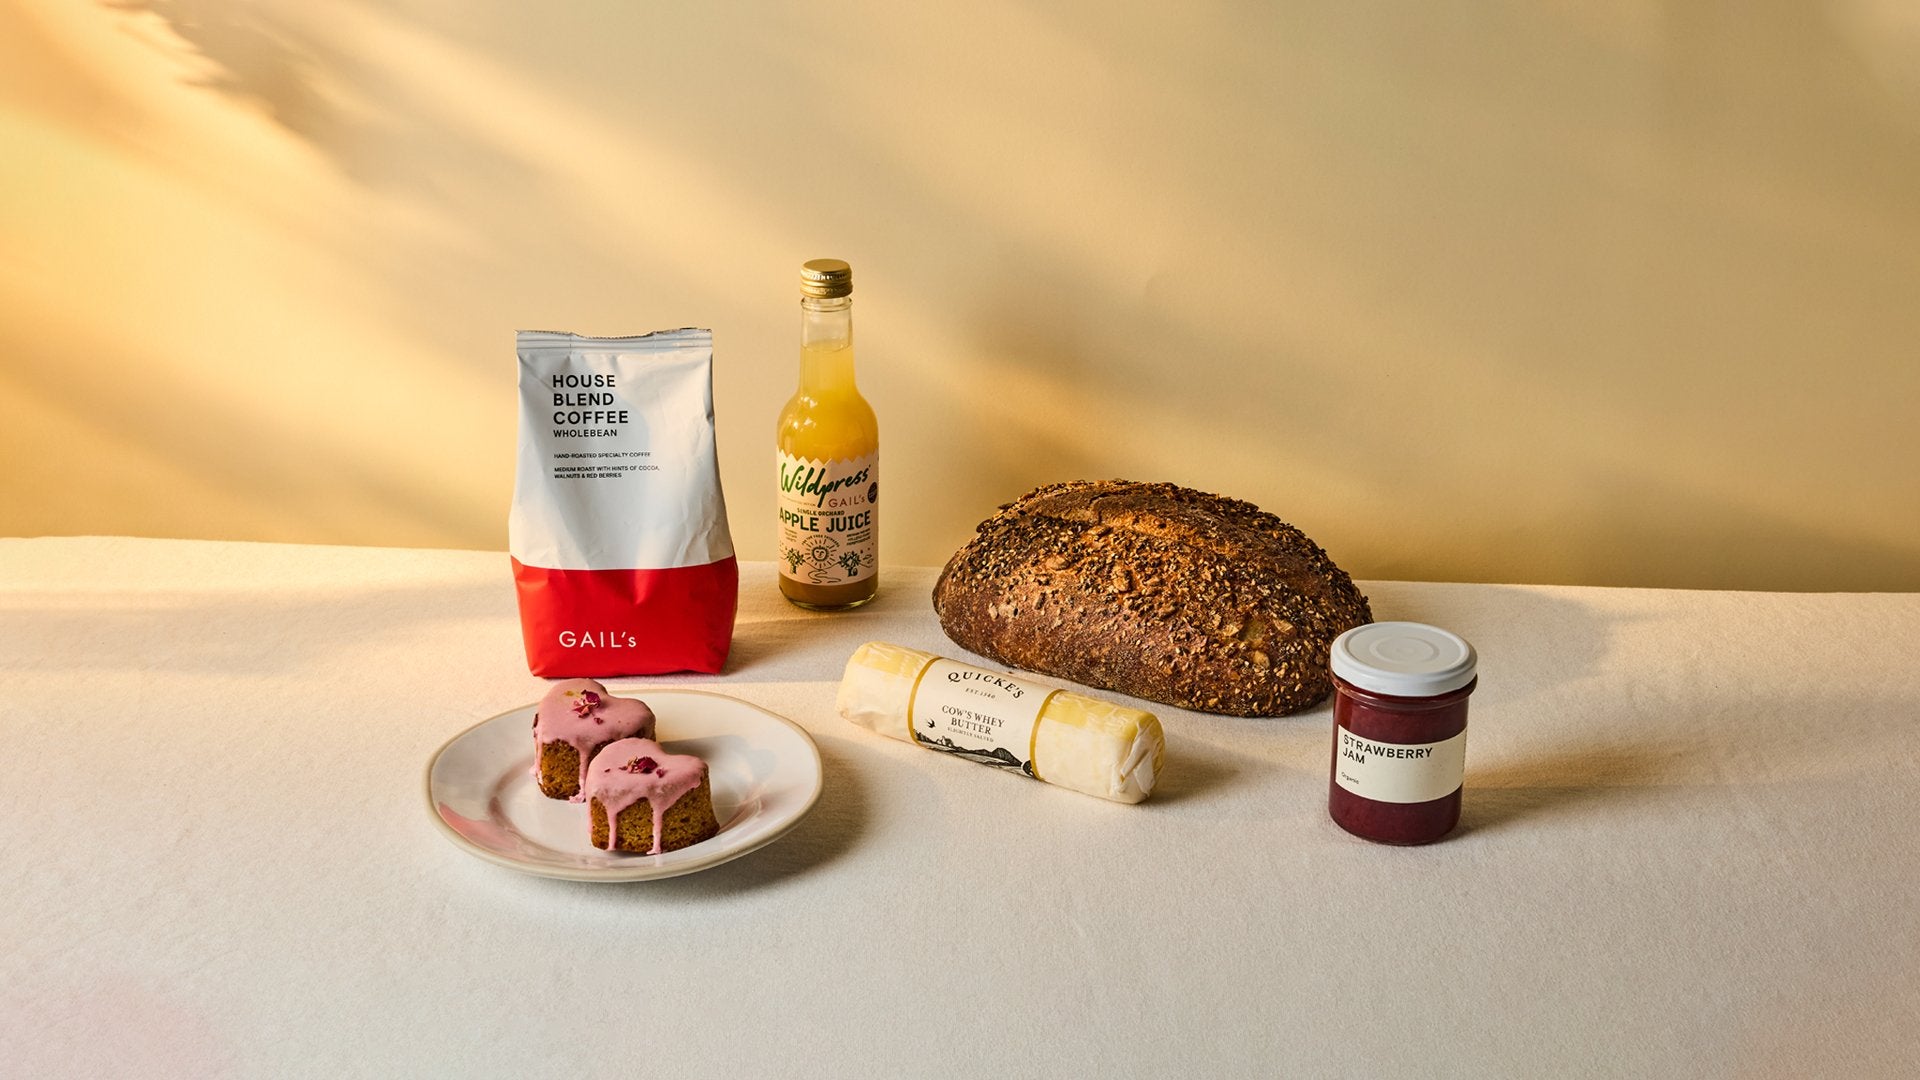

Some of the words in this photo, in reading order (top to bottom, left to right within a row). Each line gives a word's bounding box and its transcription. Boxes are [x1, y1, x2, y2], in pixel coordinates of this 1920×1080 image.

[552, 374, 616, 388] HOUSE
[553, 393, 614, 406] BLEND
[553, 411, 629, 425] COFFEE
[553, 429, 618, 438] WHOLEBEAN
[780, 462, 868, 508] Wildpress
[828, 495, 866, 508] GAIL's
[779, 506, 819, 532] APPLE
[826, 509, 871, 533] JUICE
[559, 630, 637, 648] GAIL's
[947, 671, 1025, 699] QUICKE'S
[942, 704, 973, 720] COW'S
[974, 712, 1005, 728] WHEY
[950, 717, 992, 736] BUTTER
[1342, 747, 1365, 764] JAM
[1343, 734, 1433, 759] STRAWBERRY
